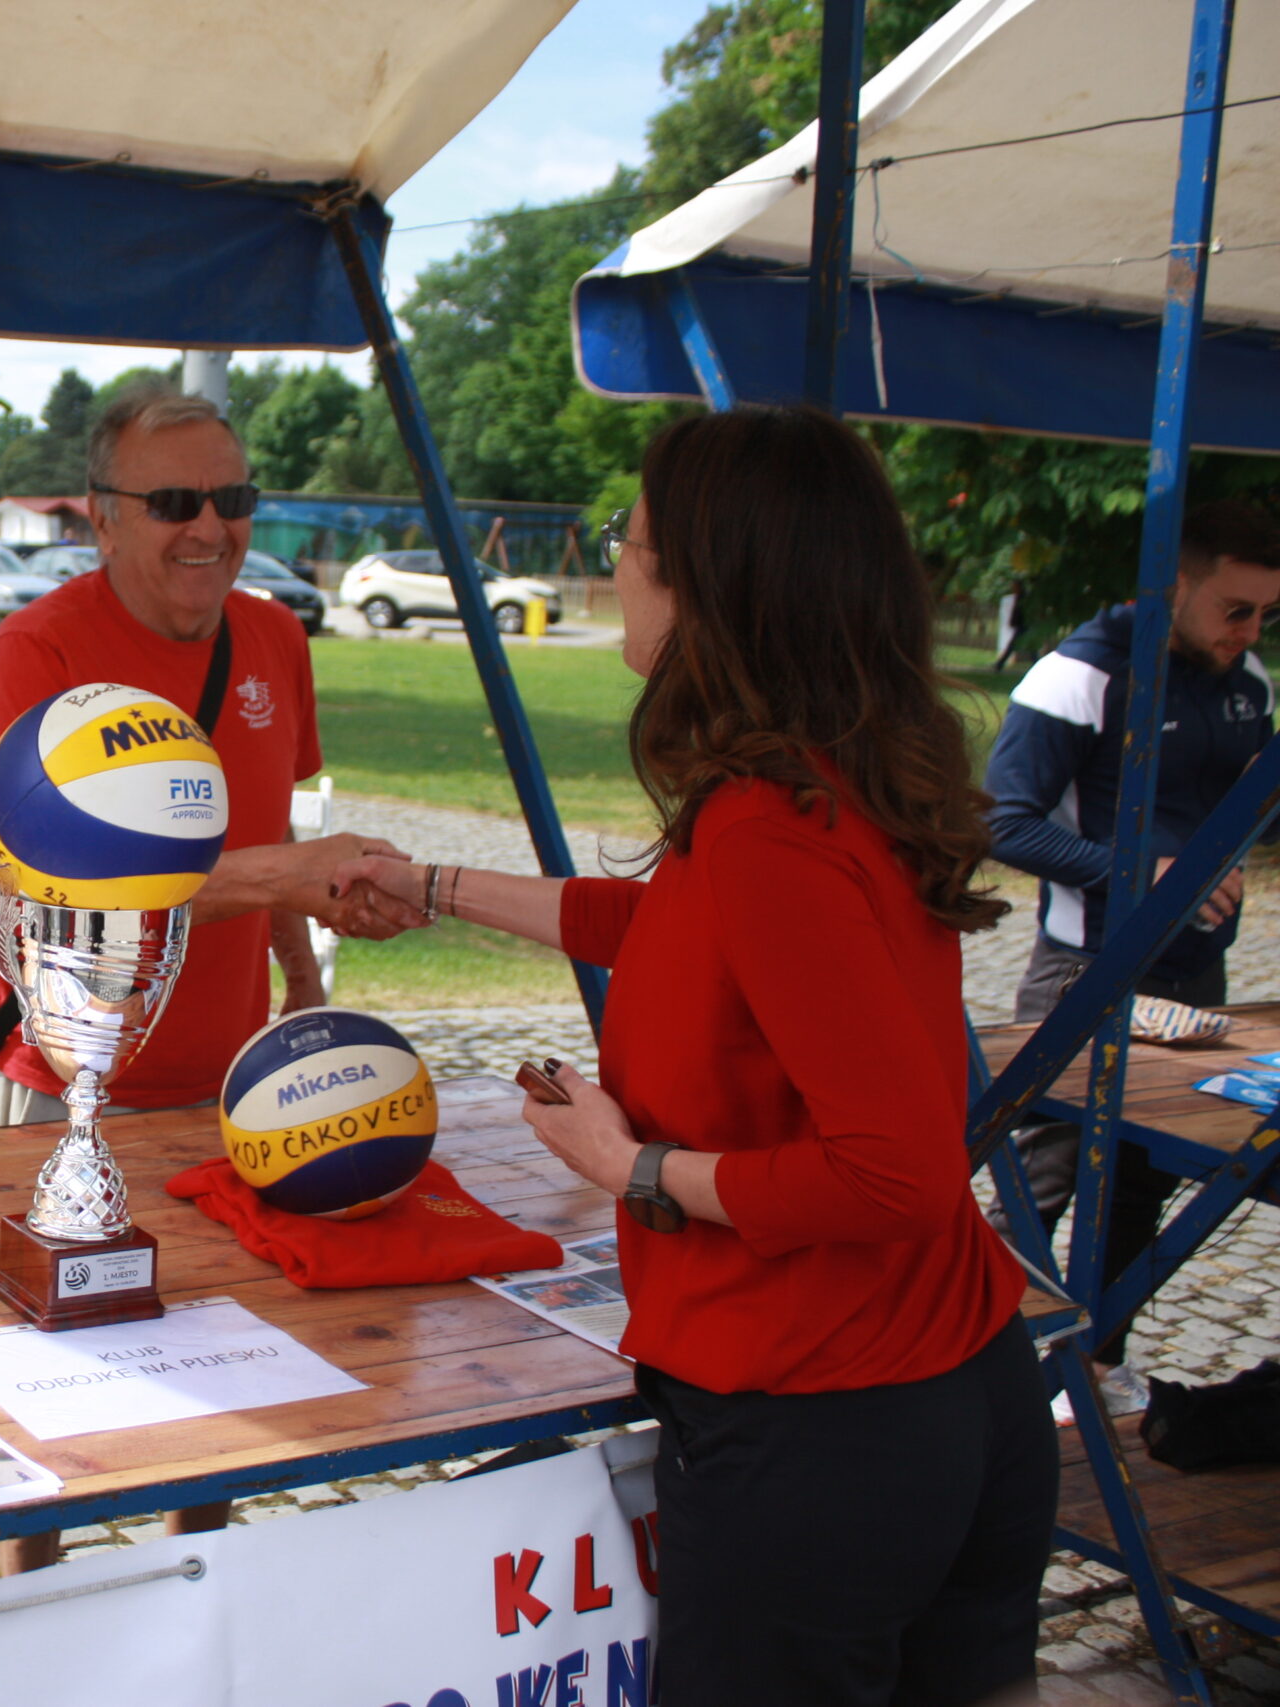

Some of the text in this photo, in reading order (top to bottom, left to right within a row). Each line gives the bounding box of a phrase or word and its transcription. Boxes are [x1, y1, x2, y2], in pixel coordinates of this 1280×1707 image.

[100, 718, 214, 758] MIKAS
[169, 779, 213, 799] FIVB
[171, 810, 214, 820] APPROVED
[277, 1064, 378, 1109] MIKASA
[231, 1096, 417, 1169] KOP ČAKOVEC
[111, 1270, 138, 1279] MJESTO
[16, 1346, 279, 1393] ODBOJKE NA PIJESKU
[97, 1345, 164, 1363] KLUB
[494, 1511, 659, 1637] KLU
